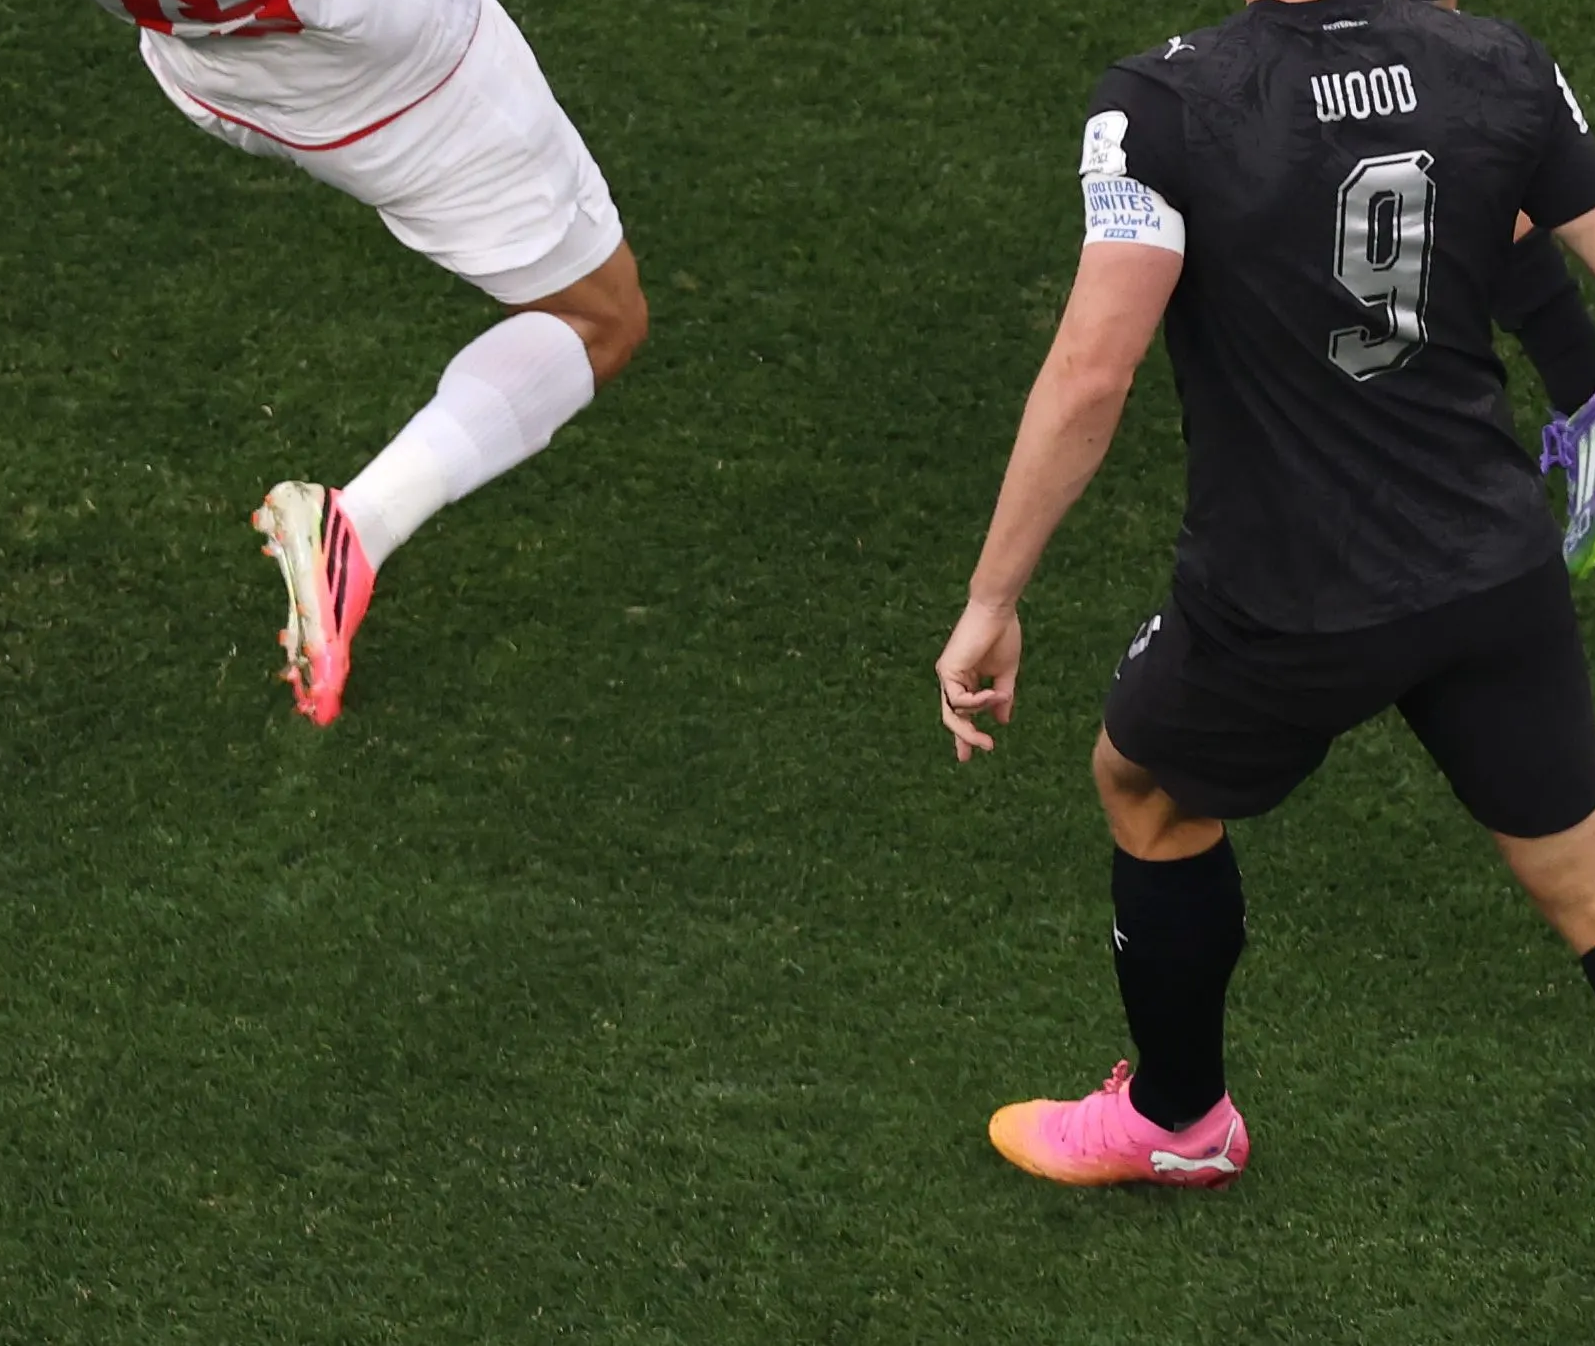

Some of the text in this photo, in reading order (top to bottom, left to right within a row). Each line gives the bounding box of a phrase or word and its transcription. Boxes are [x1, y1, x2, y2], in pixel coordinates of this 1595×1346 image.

[1311, 64, 1417, 122] WOOD
[1087, 181, 1150, 195] FOOTBALL
[1089, 194, 1154, 212] UNITES
[1090, 213, 1161, 230] the World
[1328, 150, 1435, 382] 9
